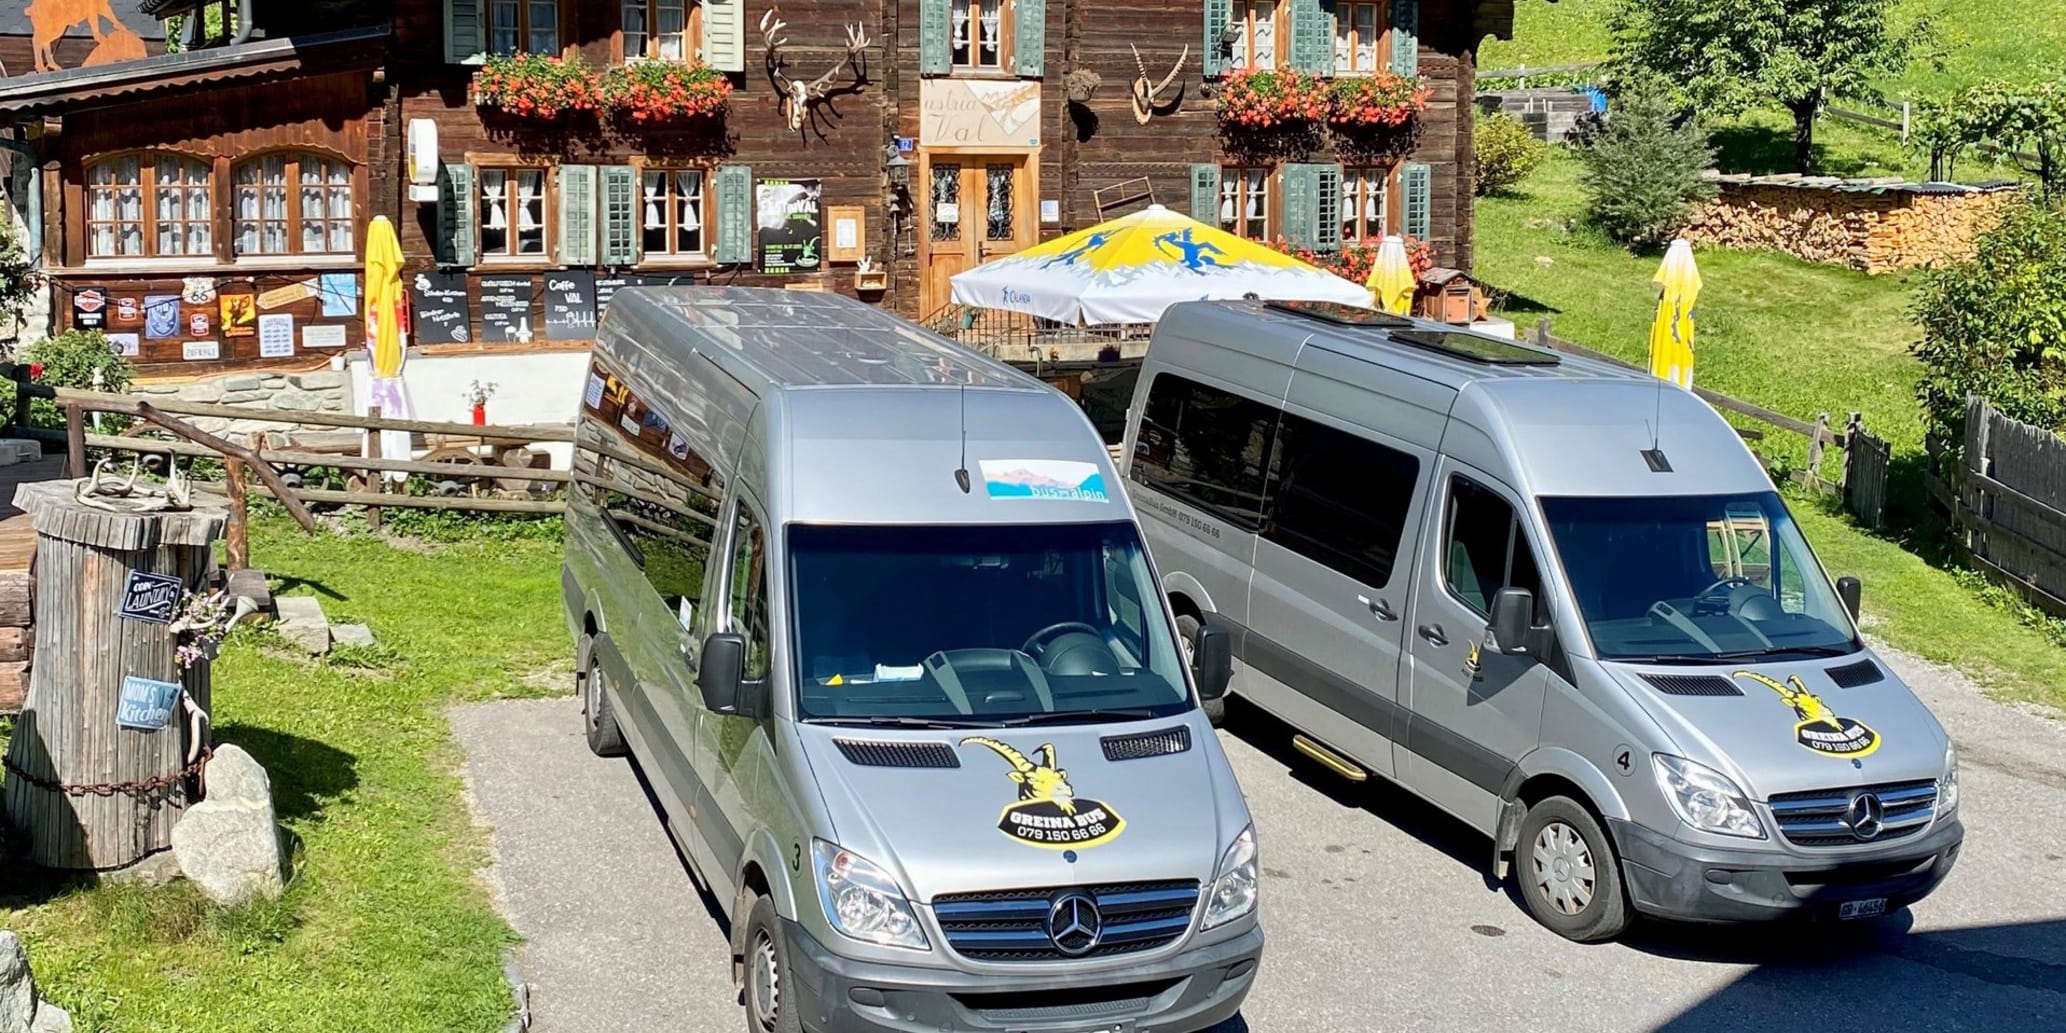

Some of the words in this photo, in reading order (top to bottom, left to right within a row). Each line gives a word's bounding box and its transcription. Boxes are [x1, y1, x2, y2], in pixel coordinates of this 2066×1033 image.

[549, 279, 576, 290] Caffe
[564, 292, 583, 303] VAL
[120, 701, 168, 722] Kitchen
[1616, 750, 1630, 770] 4
[1010, 811, 1076, 829] GREINA
[1073, 807, 1107, 827] BUS
[1017, 826, 1044, 840] 079
[1045, 830, 1071, 841] 150
[1071, 828, 1090, 840] 66
[1088, 822, 1106, 836] 66
[792, 842, 801, 872] 3
